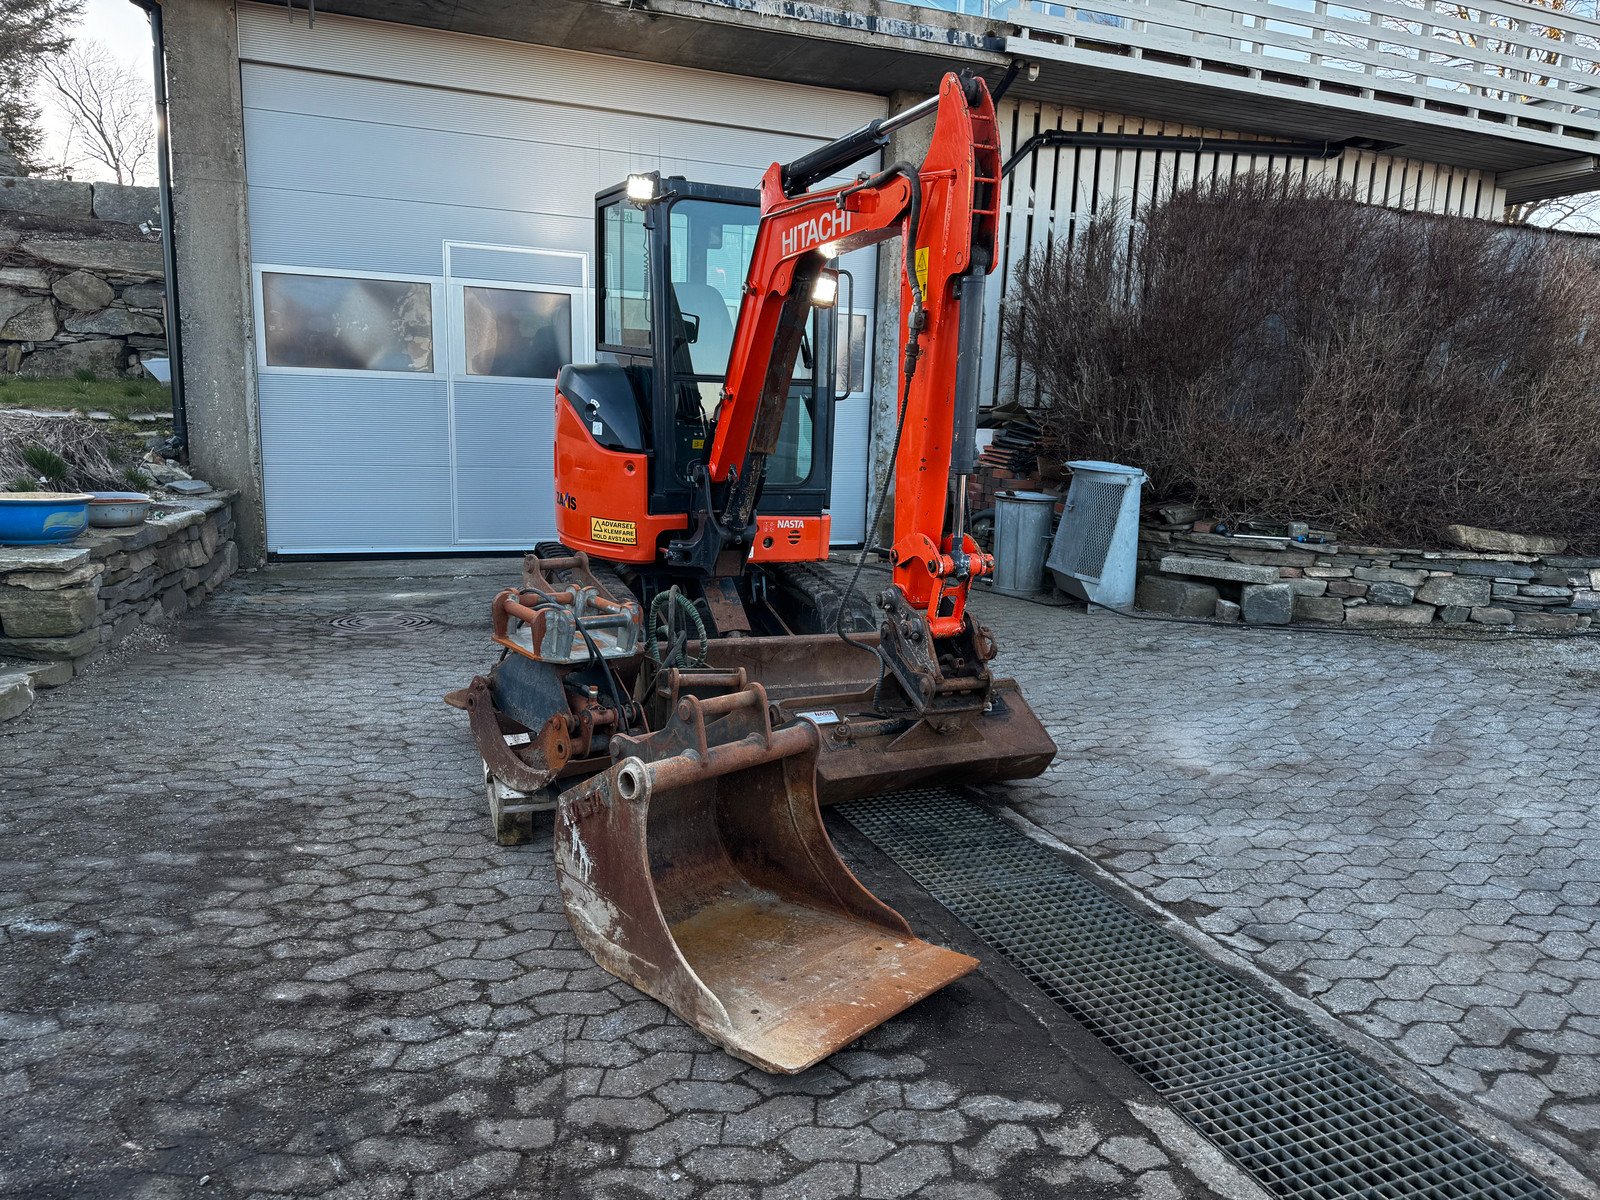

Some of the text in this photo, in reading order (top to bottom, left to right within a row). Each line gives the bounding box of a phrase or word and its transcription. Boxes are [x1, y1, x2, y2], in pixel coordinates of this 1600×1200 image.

[781, 209, 851, 256] HITACHI
[601, 521, 633, 529] ADVARSEL
[777, 519, 804, 528] NASTA
[608, 535, 635, 543] AVSTAND
